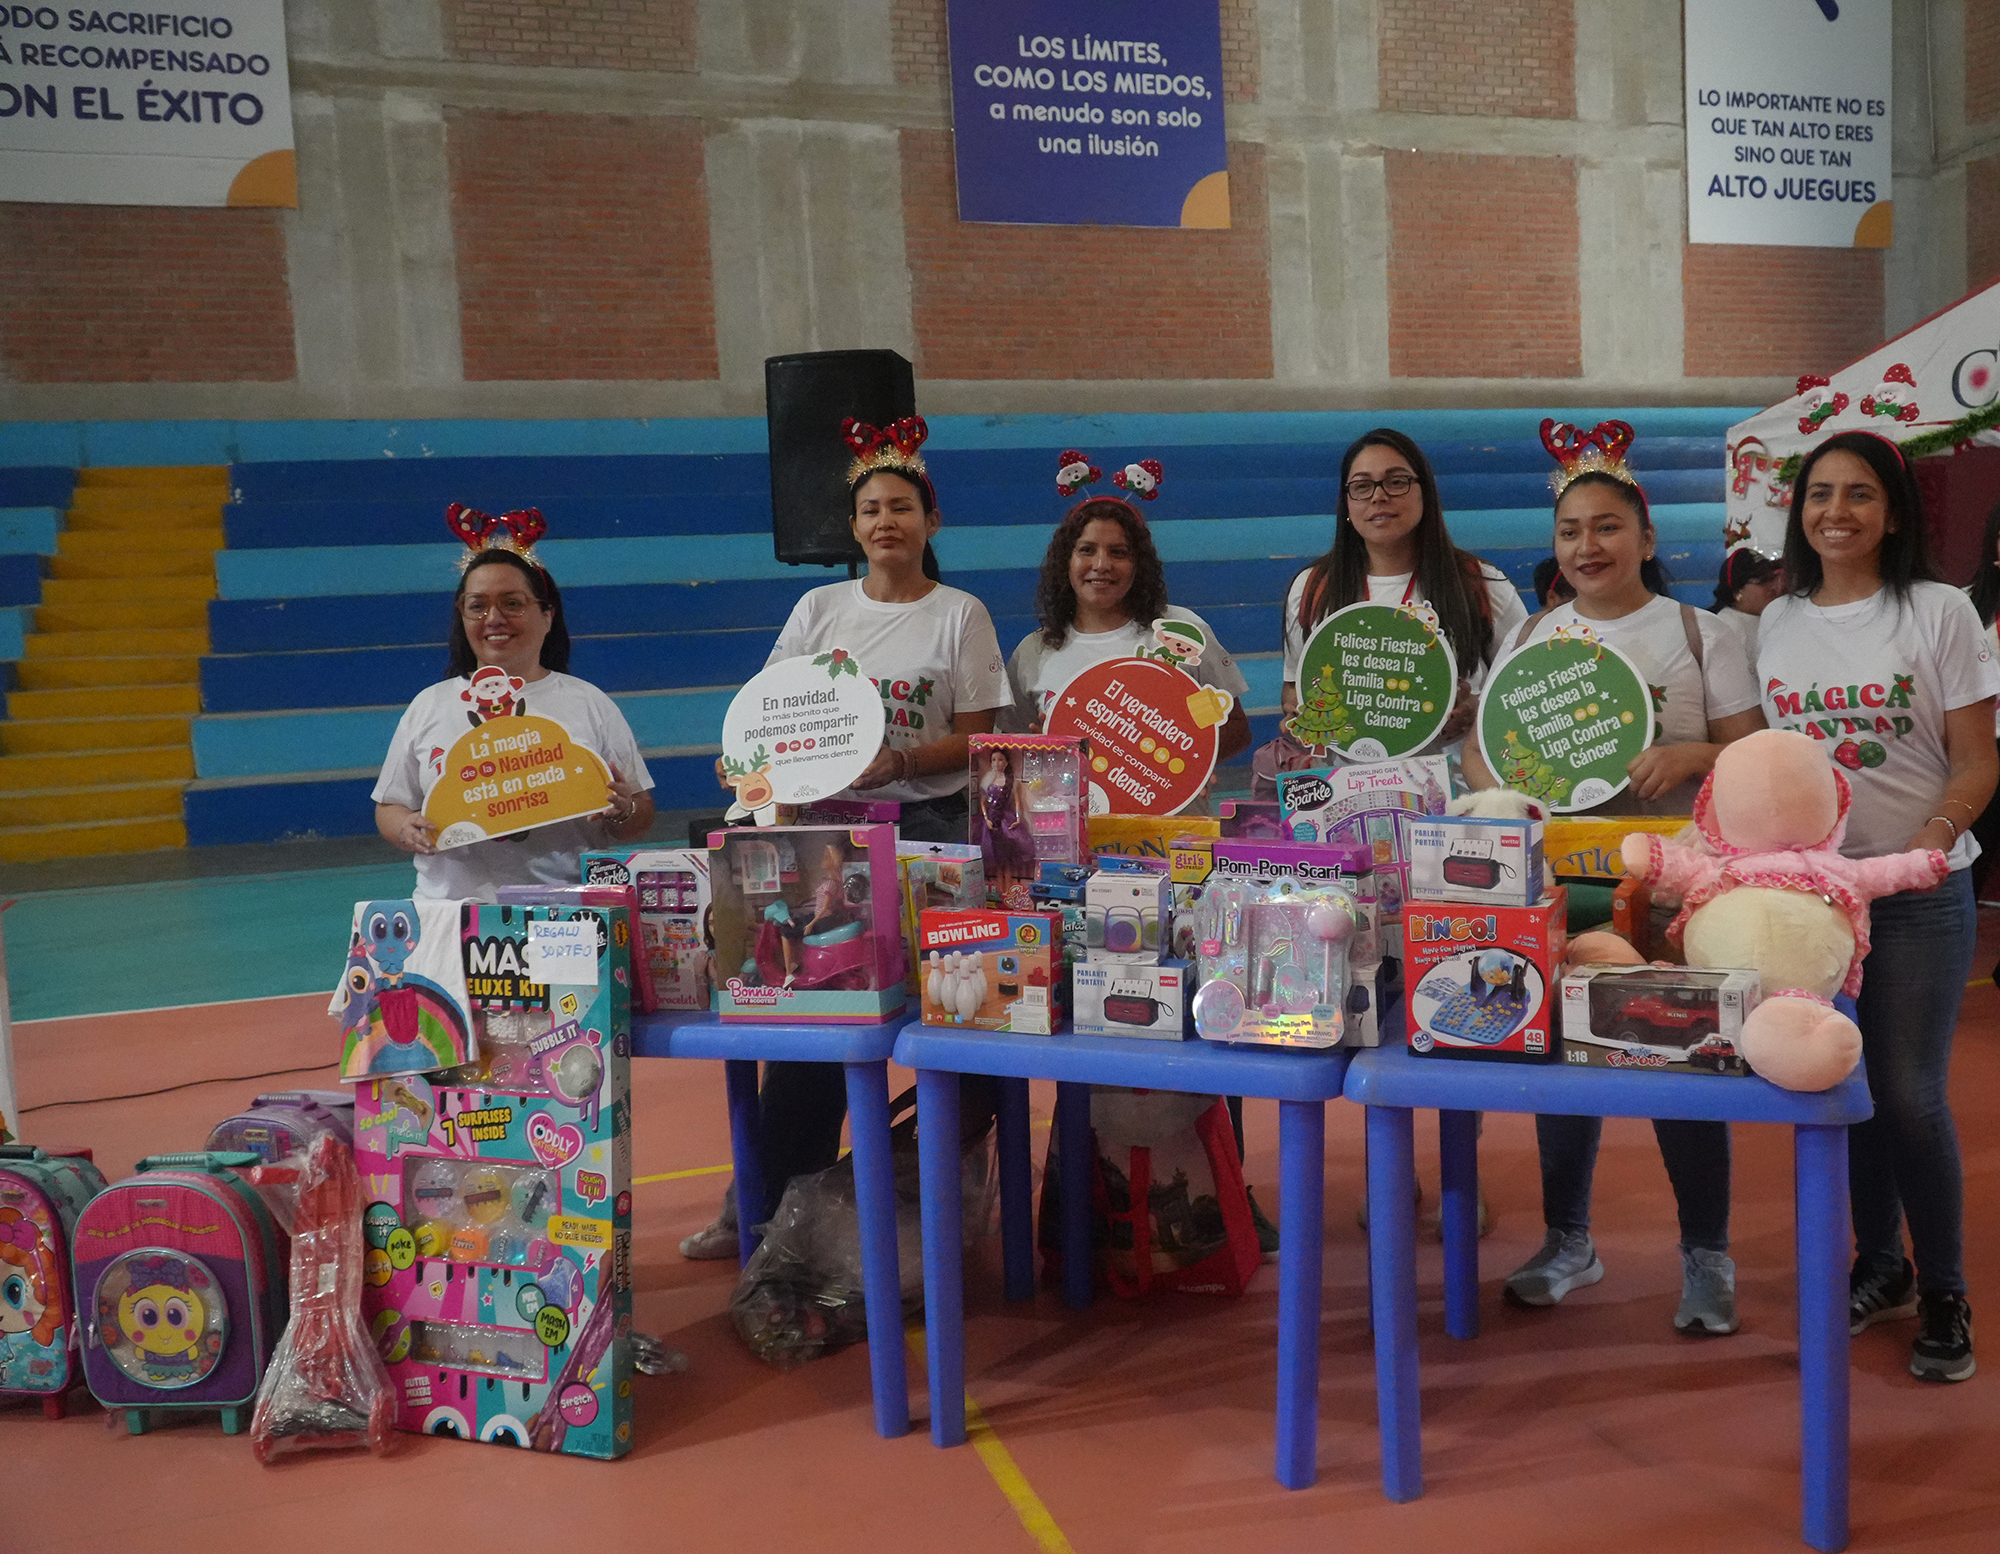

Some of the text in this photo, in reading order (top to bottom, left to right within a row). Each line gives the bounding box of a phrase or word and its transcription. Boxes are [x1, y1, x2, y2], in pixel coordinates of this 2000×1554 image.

[68, 9, 233, 39] SACRIFICIO
[20, 43, 270, 76] RECOMPENSADO
[1019, 33, 1168, 67] LOS LÍMITES,
[974, 64, 1213, 100] COMO LOS MIEDOS,
[73, 86, 124, 120] EL
[137, 79, 264, 126] ÉXITO
[1699, 89, 1886, 117] LO IMPORTANTE NO ES
[989, 102, 1202, 128] a menudo son solo
[1711, 117, 1874, 142] QUE TAN ALTO ERES
[1038, 133, 1159, 157] una ilusión
[1734, 146, 1852, 168] SINO QUE TAN
[1708, 174, 1877, 203] ALTO JUEGUES
[1334, 632, 1427, 656] Felices Fiestas
[1341, 651, 1415, 673] les desea la
[1342, 670, 1384, 690] familia
[1500, 658, 1598, 710] Felices Fiestas
[763, 688, 839, 711] En navidad.
[1346, 690, 1421, 713] Liga Contra
[1517, 681, 1596, 724] les desea la
[1774, 682, 1911, 718] MÁGICA
[763, 706, 840, 722] lo más bonito que
[1086, 698, 1142, 744] espíritu
[1103, 679, 1194, 751] El verdadero
[1364, 711, 1411, 730] Cáncer
[744, 714, 859, 742] podemos compartir
[1528, 713, 1574, 742] familia
[1540, 716, 1622, 760] Liga Contra
[470, 728, 542, 760] La magia
[819, 732, 854, 748] amor
[461, 743, 564, 778] de la Navidad
[775, 748, 858, 767] que llevamos dentro
[1073, 717, 1173, 790] navidad es compartir
[1569, 738, 1619, 769] Cáncer
[463, 765, 565, 804] está en cada
[1348, 774, 1403, 792] Lip Treats
[1349, 768, 1383, 778] SPARKLING
[1107, 765, 1157, 807] demás
[487, 791, 549, 818] sonrisa
[1285, 787, 1331, 811] Sparkle
[1415, 829, 1446, 838] PARLANTE
[1175, 853, 1204, 870] girl's
[1218, 857, 1341, 880] Pom-Pom Scarf
[588, 869, 629, 886] Sparkle
[1530, 915, 1541, 924] 3+
[927, 923, 1000, 945] BOWLING
[1414, 956, 1431, 965] Bingo
[1432, 955, 1440, 964] at
[1422, 947, 1439, 955] Have
[1440, 944, 1452, 952] fun
[1076, 970, 1107, 978] PARLANTE
[727, 978, 776, 998] Bonnie
[1667, 1011, 1688, 1019] KING
[530, 1023, 579, 1056] BUBBLE IT
[1414, 1033, 1429, 1045] 90
[1526, 1032, 1543, 1044] 48
[1566, 1050, 1588, 1063] 1:18
[458, 1108, 511, 1127] SURPRISES
[442, 1119, 455, 1147] 7
[472, 1125, 506, 1141] INSIDE
[533, 1122, 574, 1151] ODDLY
[379, 1226, 388, 1237] it
[555, 1231, 564, 1240] NO
[540, 1312, 566, 1331] MASH
[574, 1406, 582, 1416] it
